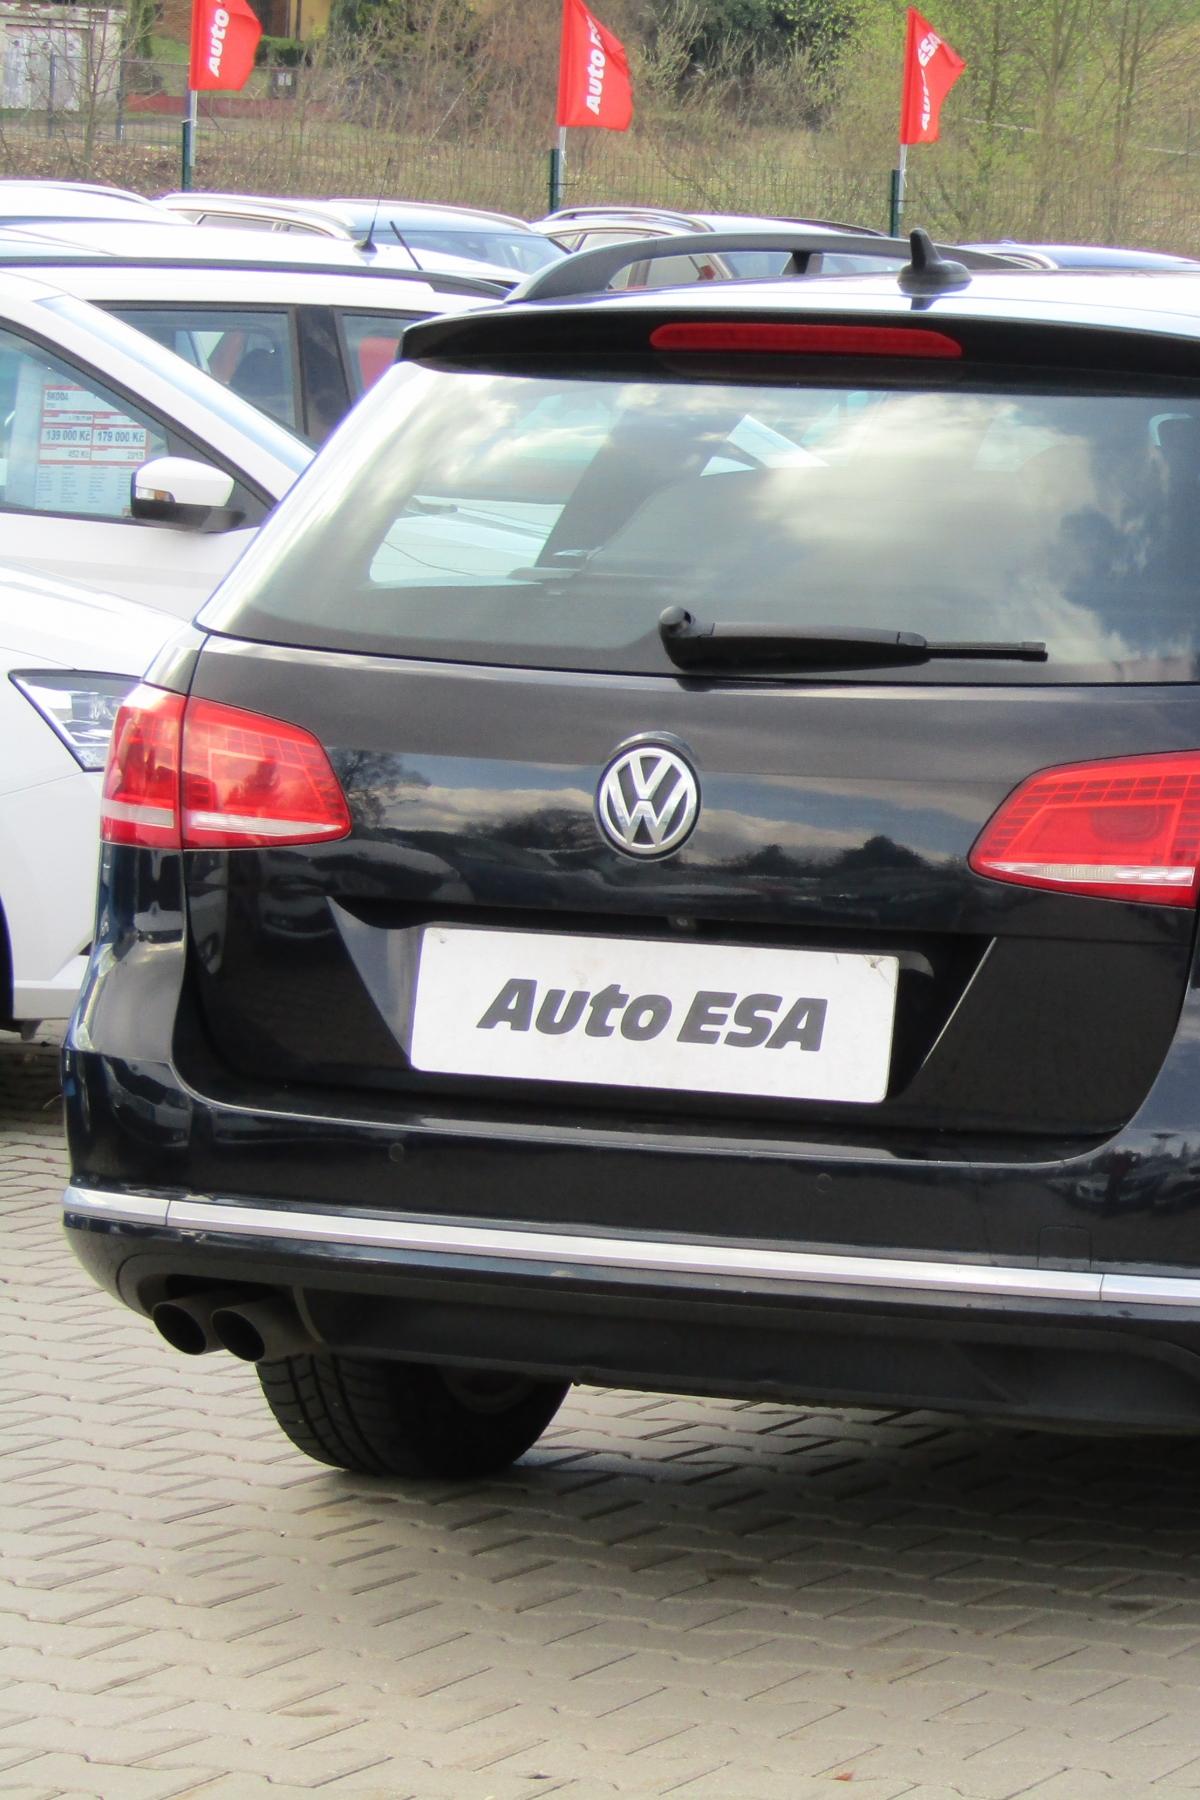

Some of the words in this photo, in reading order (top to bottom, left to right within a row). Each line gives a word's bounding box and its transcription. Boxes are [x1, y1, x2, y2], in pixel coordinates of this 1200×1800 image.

[208, 8, 229, 78] Auto
[586, 48, 605, 115] Auto
[46, 430, 61, 441] 139
[63, 430, 78, 441] 000
[80, 430, 91, 441] Kč
[98, 431, 112, 442] 179
[115, 431, 130, 442] 000
[476, 978, 672, 1041] Auto
[676, 990, 828, 1052] ESA
